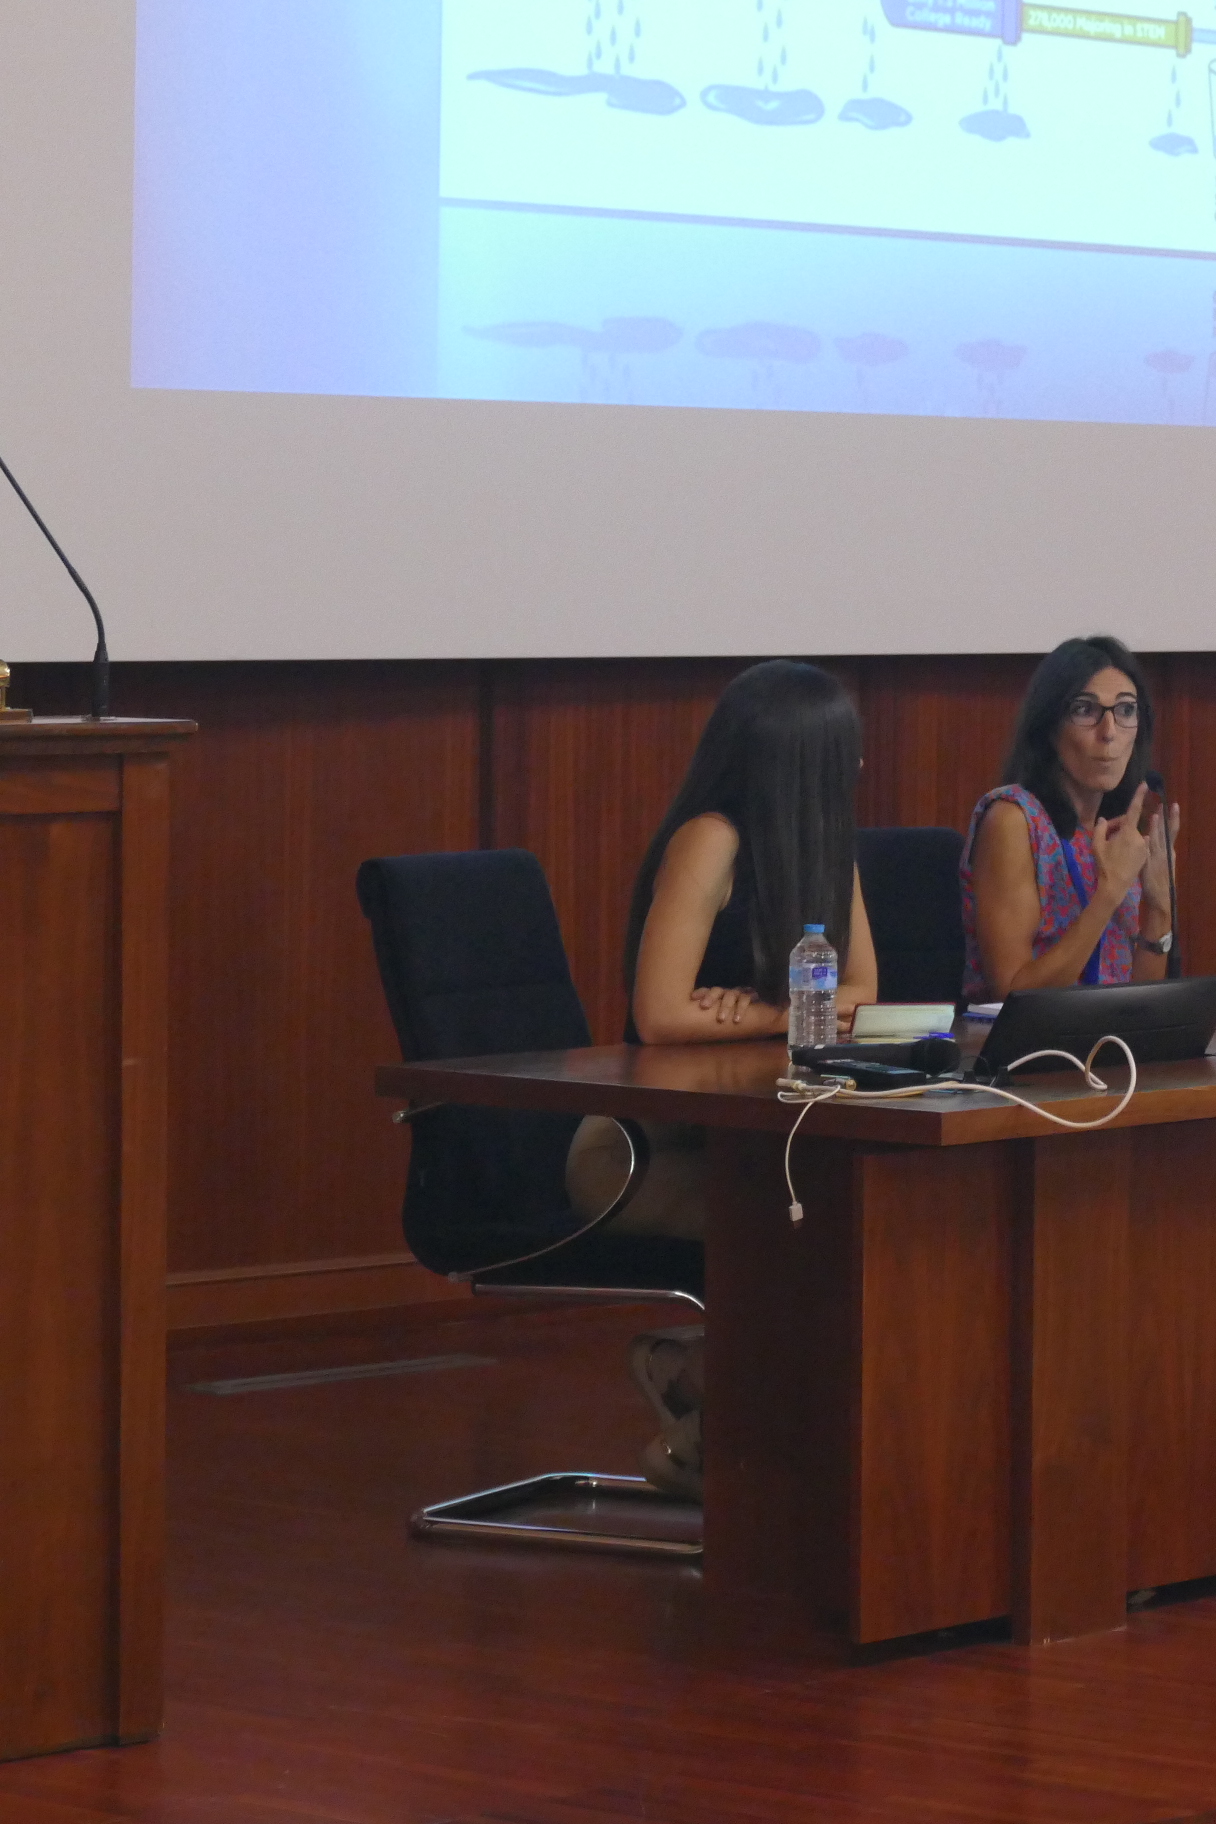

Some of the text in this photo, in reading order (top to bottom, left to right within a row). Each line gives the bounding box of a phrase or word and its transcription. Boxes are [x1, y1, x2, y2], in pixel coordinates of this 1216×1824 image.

[906, 6, 991, 32] College Ready
[1076, 17, 1122, 38] Majoring
[1124, 22, 1134, 35] in
[1136, 22, 1165, 39] STEM
